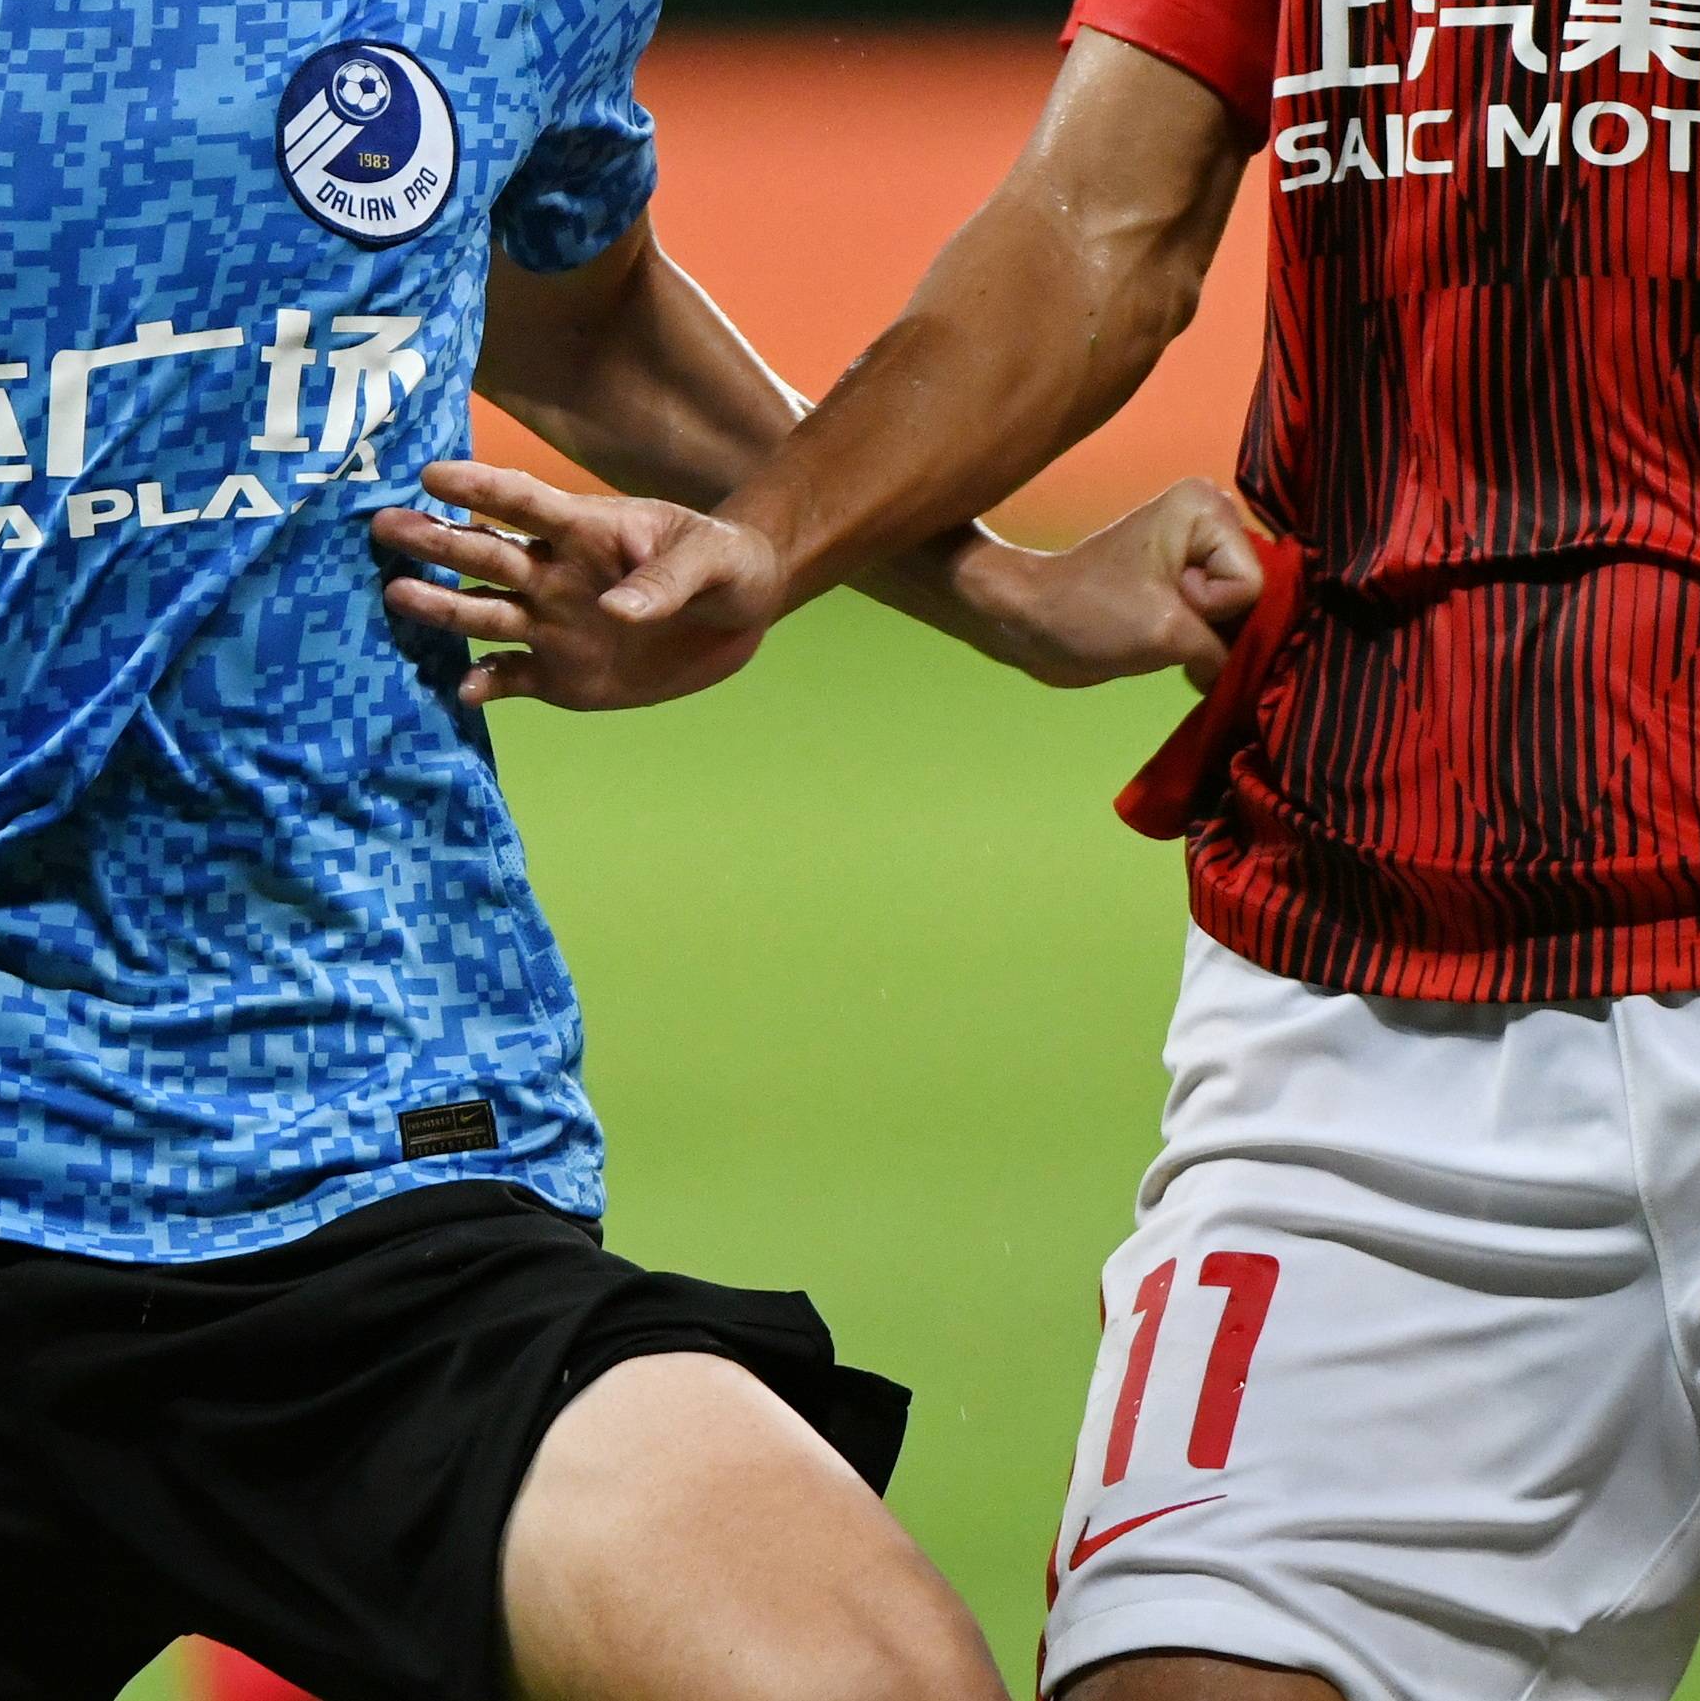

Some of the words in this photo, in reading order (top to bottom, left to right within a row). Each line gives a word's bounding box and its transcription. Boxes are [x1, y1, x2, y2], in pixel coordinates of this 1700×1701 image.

[358, 152, 391, 170] 1983
[1273, 108, 1453, 192] SAIC
[316, 180, 397, 221] DALIAN
[403, 167, 439, 211] PRO
[1102, 1250, 1280, 1487] 11
